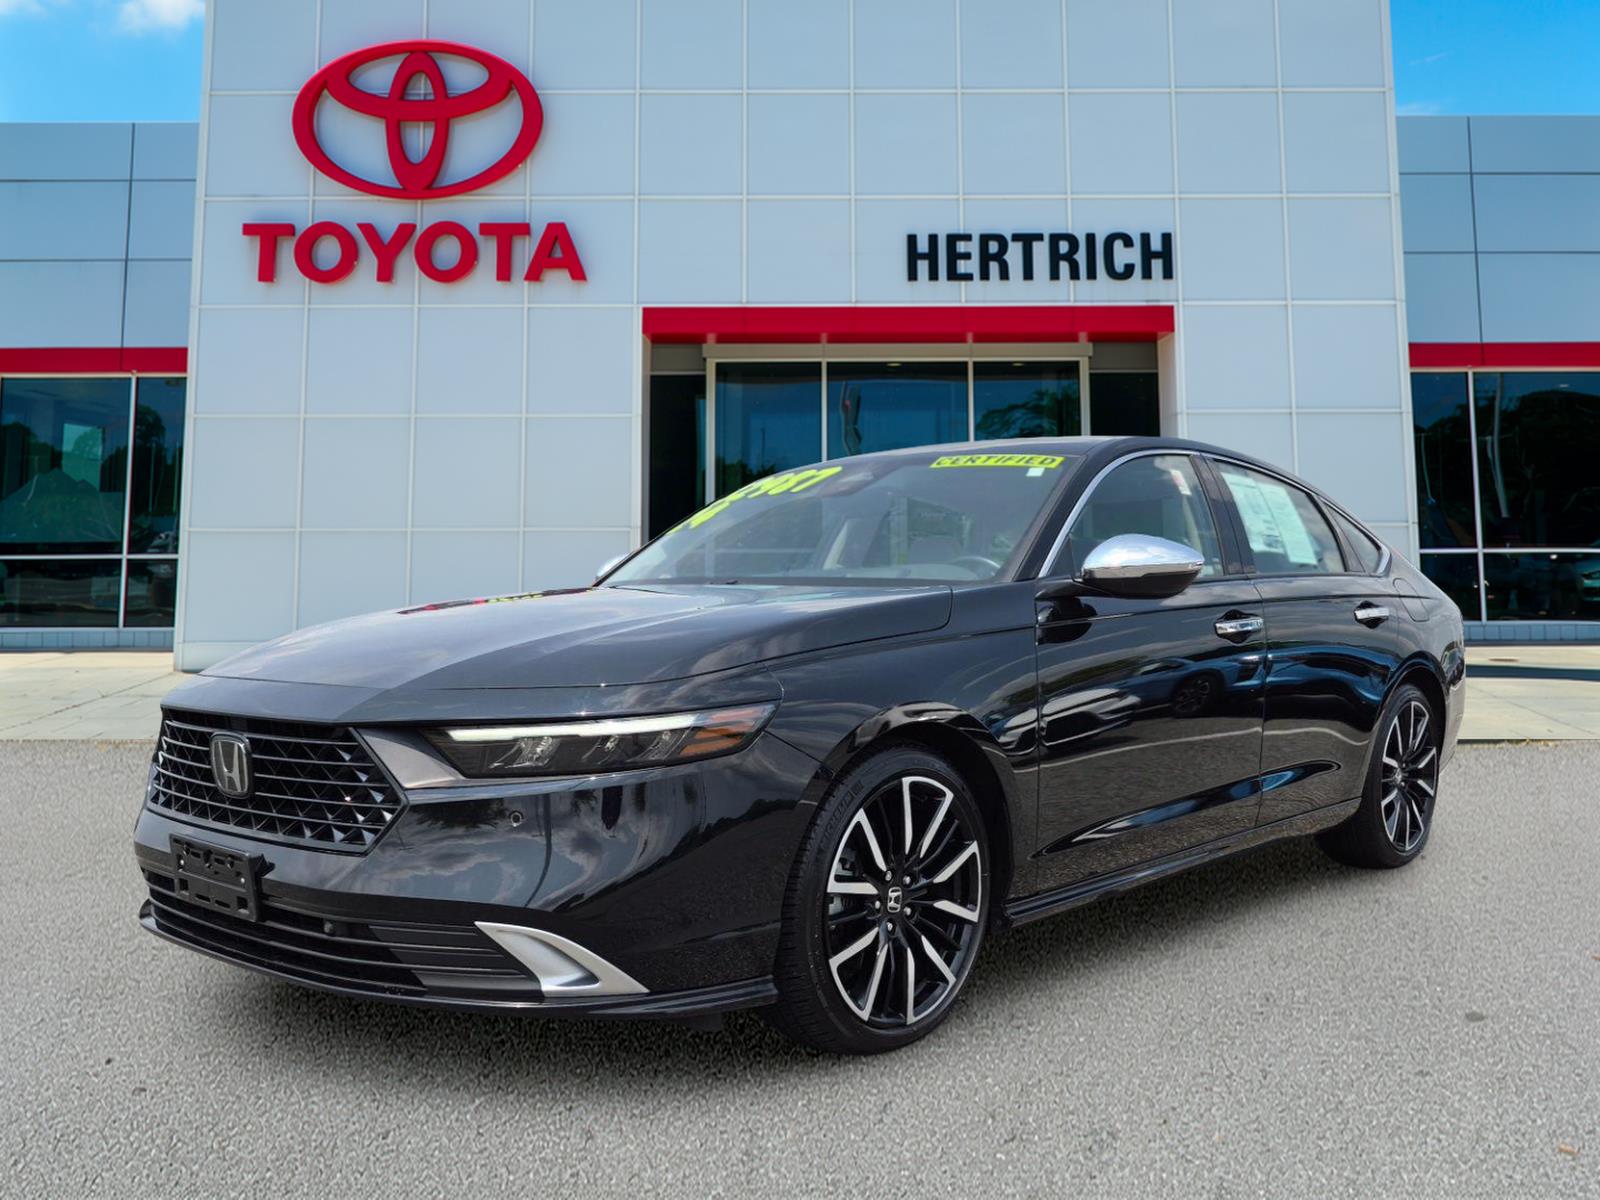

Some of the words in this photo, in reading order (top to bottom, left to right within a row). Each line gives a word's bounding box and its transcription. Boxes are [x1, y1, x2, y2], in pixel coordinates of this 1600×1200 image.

[242, 220, 587, 284] TOYOTA
[906, 232, 1174, 282] HERTRICH
[935, 455, 1058, 467] CERTIFIED
